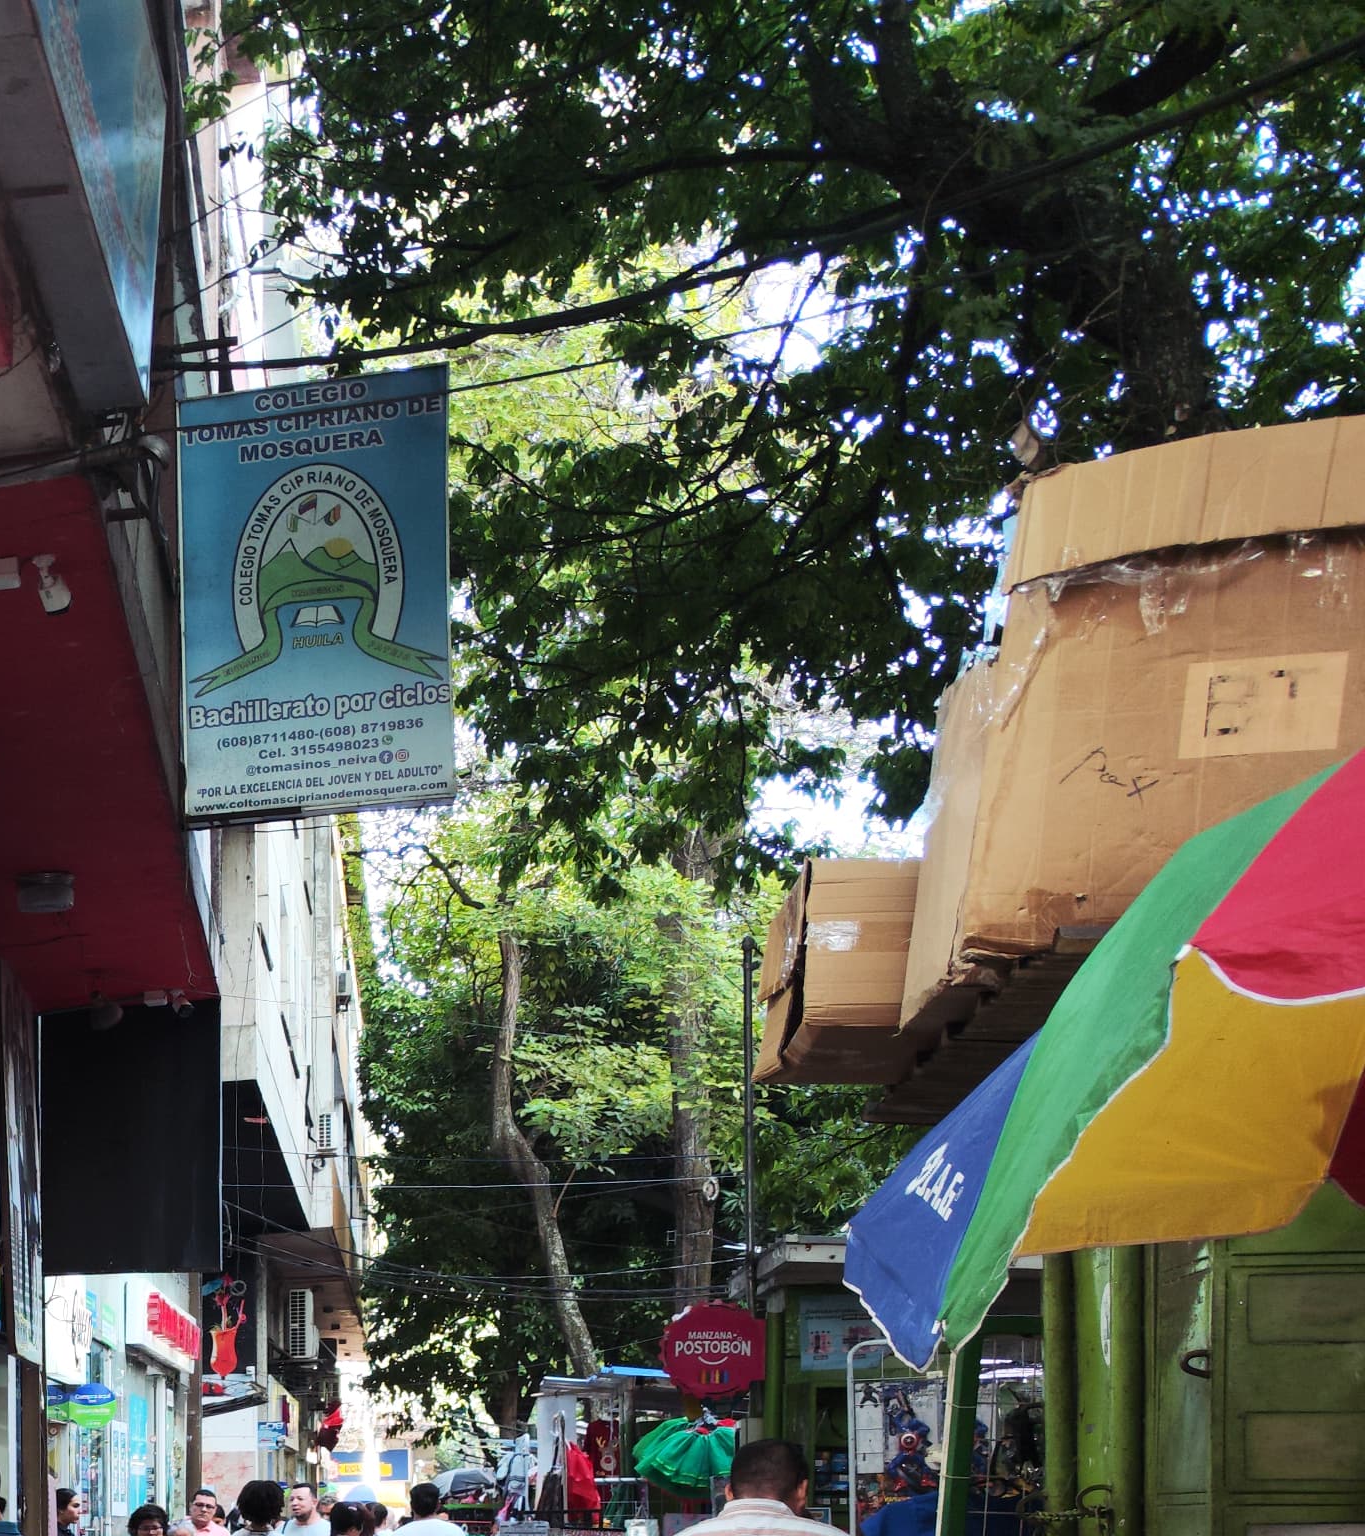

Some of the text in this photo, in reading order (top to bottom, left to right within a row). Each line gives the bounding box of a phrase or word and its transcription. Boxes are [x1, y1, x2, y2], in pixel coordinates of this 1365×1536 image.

[255, 382, 367, 413] COLEGIO
[183, 395, 441, 445] TOMAS CIPRIANO DE
[240, 429, 384, 463] MOSQUERA
[239, 470, 398, 606] COLEGIO TOMAS CIPRIANO DE MOSQUERA
[293, 632, 345, 650] HUILA
[189, 682, 451, 729] Bachillerato por ciclos
[361, 718, 424, 734] 8719836
[259, 738, 380, 760] Cel. 3155498023
[245, 754, 377, 777] @tomasinos_neiva
[194, 780, 448, 813] www.coltomasciprianodemosquera.com
[224, 785, 237, 796] LA
[240, 779, 303, 794] EXCELENCIA
[306, 776, 325, 787] DEL
[328, 773, 362, 786] JOVEN
[365, 772, 371, 781] Y
[374, 770, 394, 781] DEL
